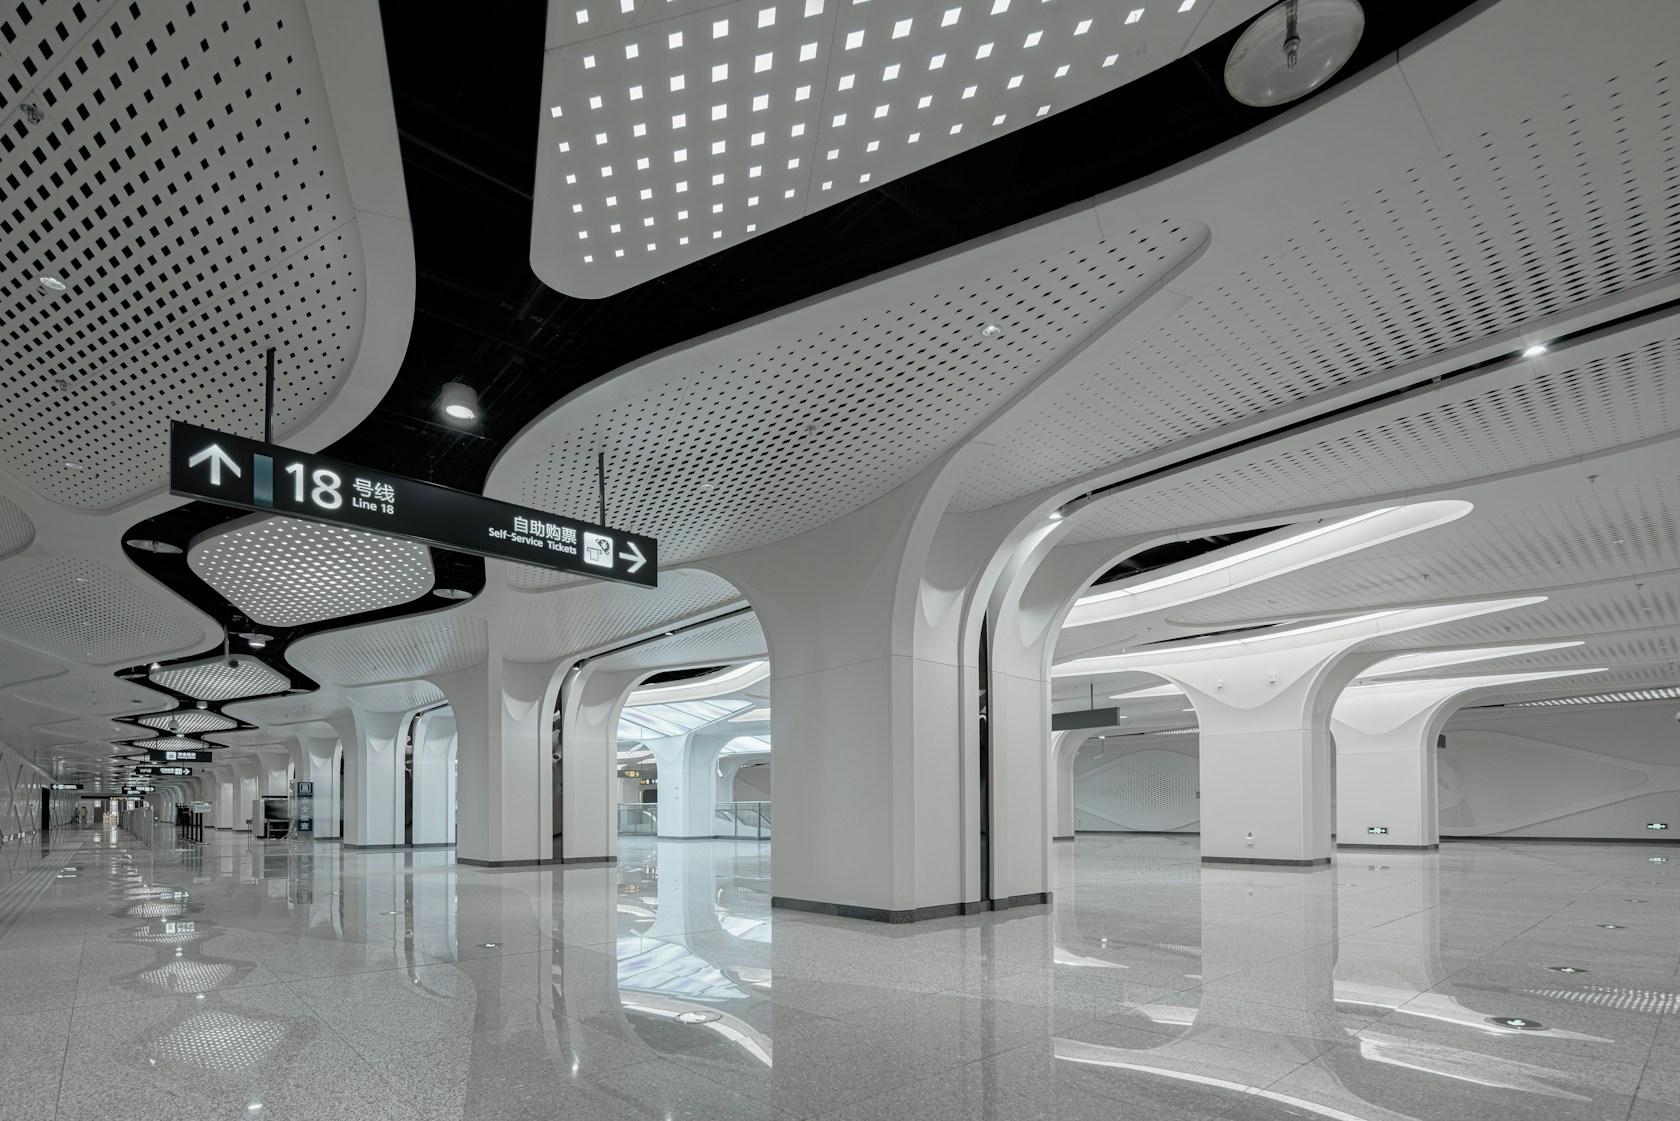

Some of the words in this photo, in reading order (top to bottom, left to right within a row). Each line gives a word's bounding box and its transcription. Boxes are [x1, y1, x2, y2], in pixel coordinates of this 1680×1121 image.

[285, 462, 342, 509] 18
[353, 478, 395, 504] 号线
[352, 497, 377, 511] Line
[380, 503, 395, 515] 18
[488, 527, 543, 548] Self-Service
[547, 540, 577, 556] Tickets
[514, 516, 577, 546] 自助购票
